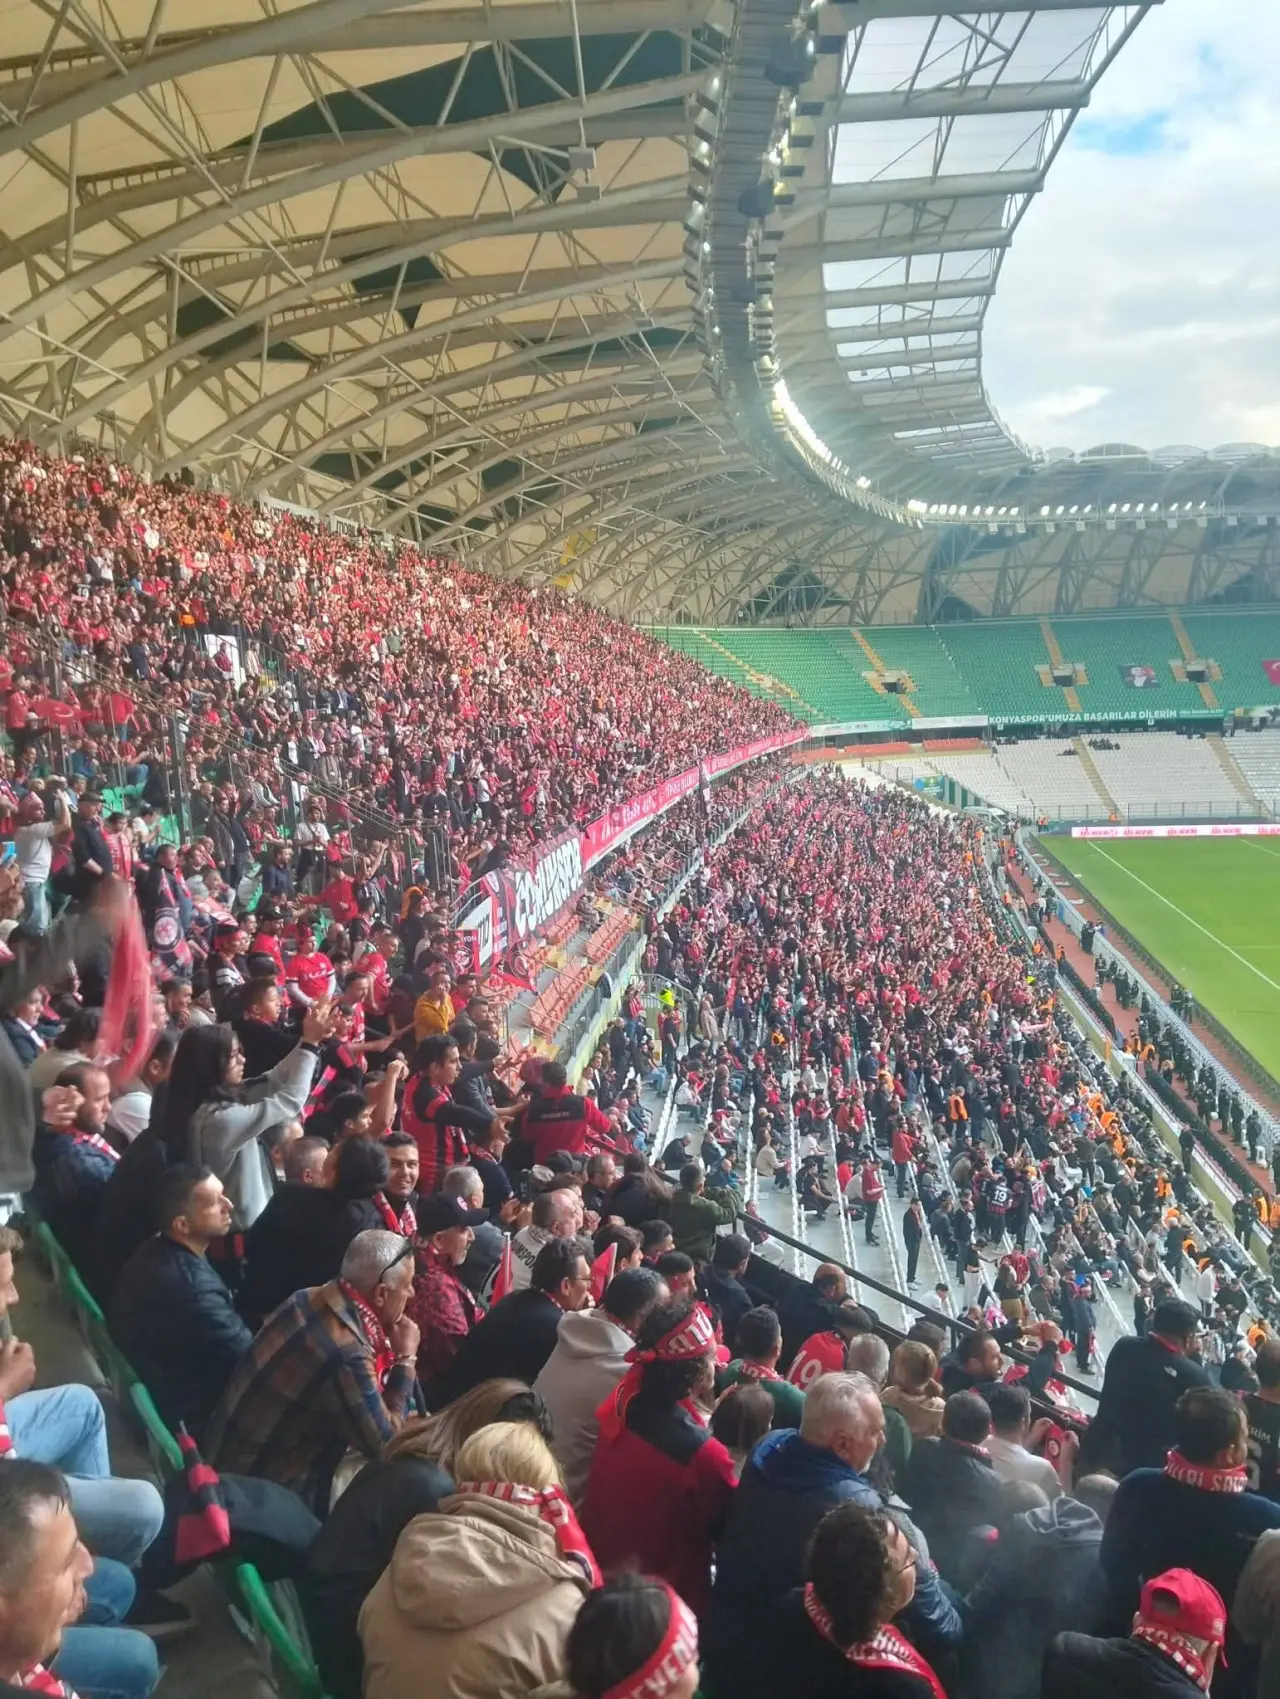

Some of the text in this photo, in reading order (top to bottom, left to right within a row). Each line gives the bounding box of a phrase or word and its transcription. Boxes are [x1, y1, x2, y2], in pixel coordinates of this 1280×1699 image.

[989, 713, 1082, 725] KONYASPOR'UMUZA
[1084, 711, 1137, 722] BAŞARILAR
[1140, 708, 1177, 720] DİLERİM
[994, 1190, 1007, 1202] 19
[787, 1350, 822, 1384] 19
